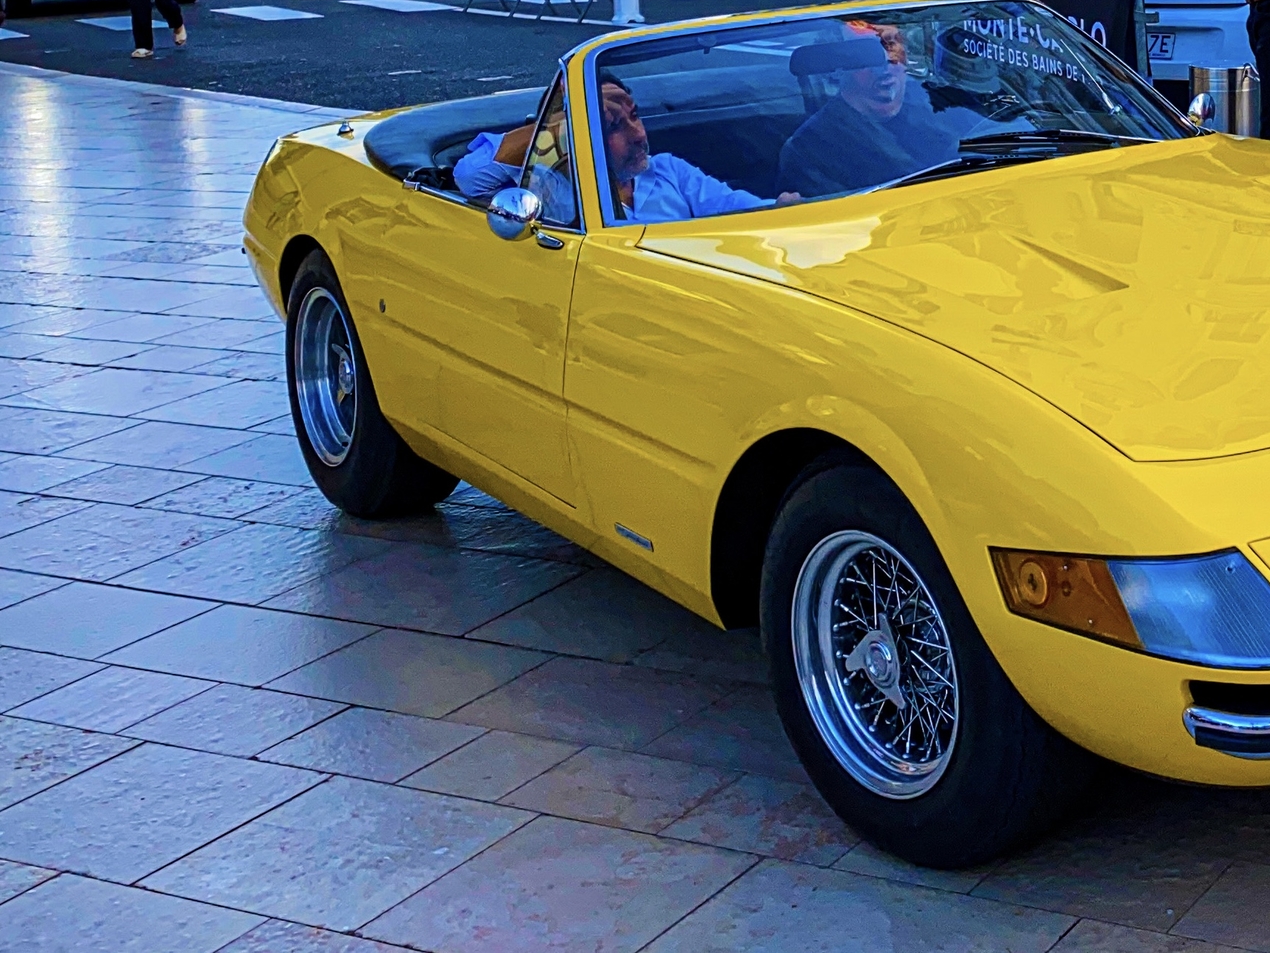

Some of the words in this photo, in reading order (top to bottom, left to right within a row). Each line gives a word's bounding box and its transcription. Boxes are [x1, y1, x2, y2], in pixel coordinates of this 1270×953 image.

[963, 38, 1005, 63] SOCIÉTÉ
[998, 48, 1029, 68] DES
[1032, 54, 1063, 77] BAINS
[1065, 63, 1078, 82] DE
